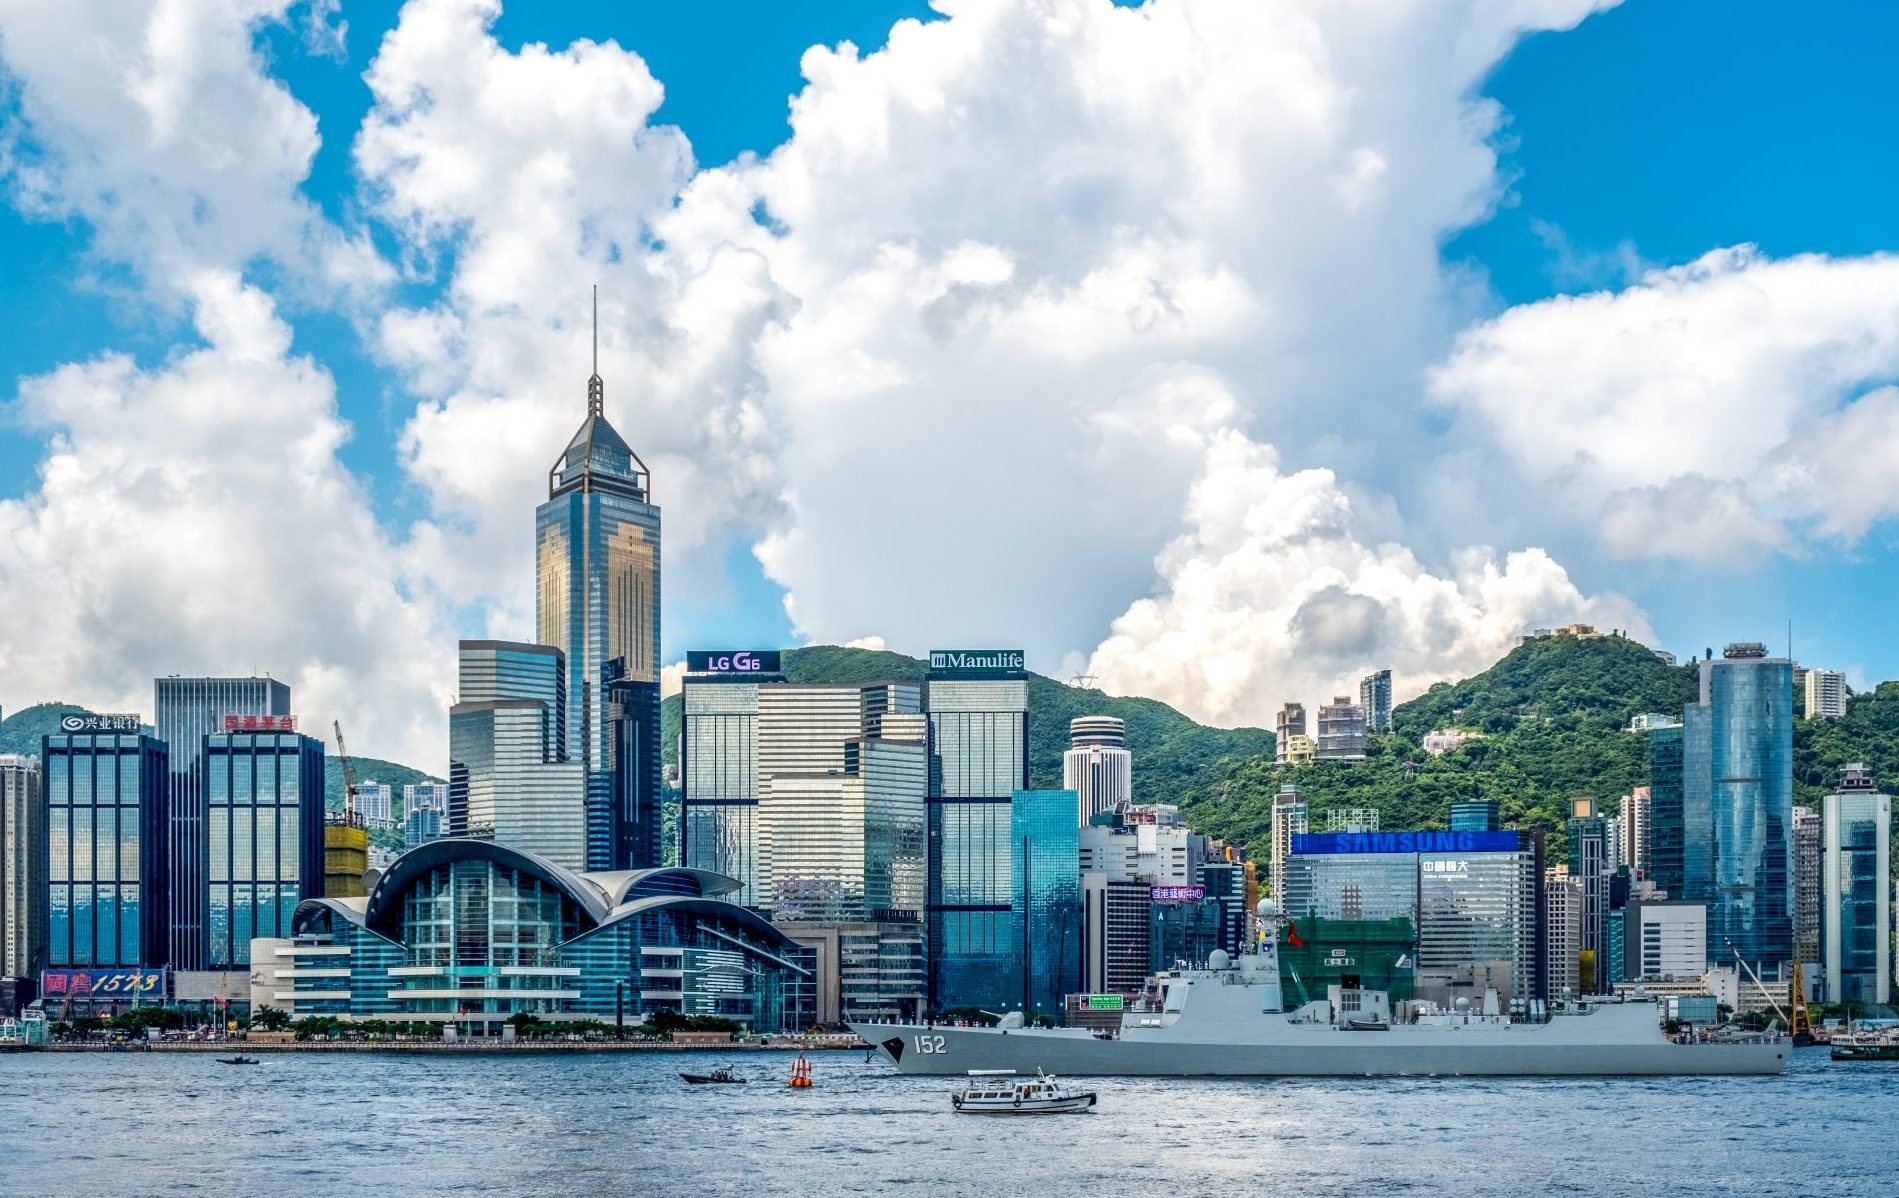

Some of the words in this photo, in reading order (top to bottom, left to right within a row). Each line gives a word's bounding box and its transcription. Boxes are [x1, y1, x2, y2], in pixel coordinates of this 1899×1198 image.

[708, 657, 729, 670] LG
[732, 652, 760, 670] G6
[946, 653, 1023, 668] Manulife
[84, 715, 140, 730] 兴业银行
[1336, 832, 1475, 853] SAMSUNG
[1151, 888, 1204, 899] 香港藝術中心
[91, 974, 159, 992] 1573
[914, 1035, 948, 1055] 152
